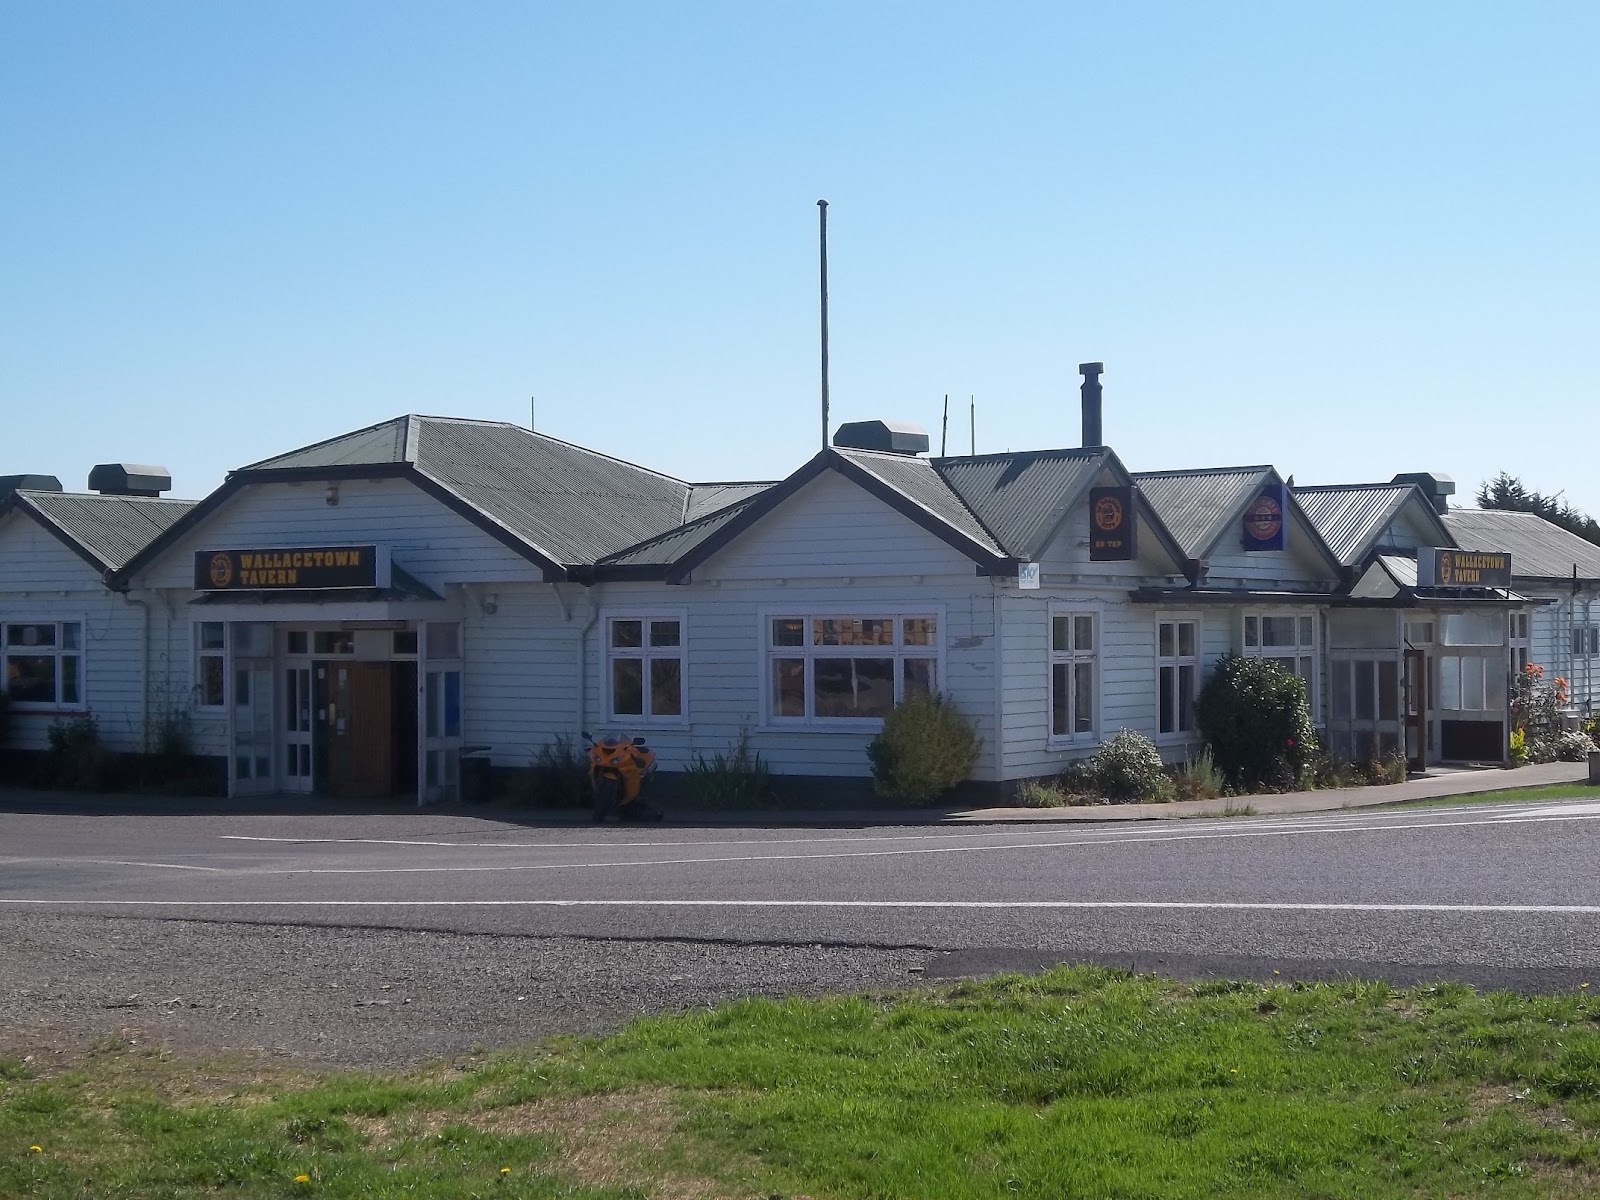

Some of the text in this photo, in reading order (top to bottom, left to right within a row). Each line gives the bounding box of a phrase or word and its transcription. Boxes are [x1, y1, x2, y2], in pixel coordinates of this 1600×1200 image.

[1095, 540, 1122, 548] ON TAP
[240, 551, 360, 569] WALLACETOWN
[1455, 554, 1505, 569] WALLACETOWN
[240, 569, 297, 585] TAVERN
[1455, 569, 1480, 583] TAVERN
